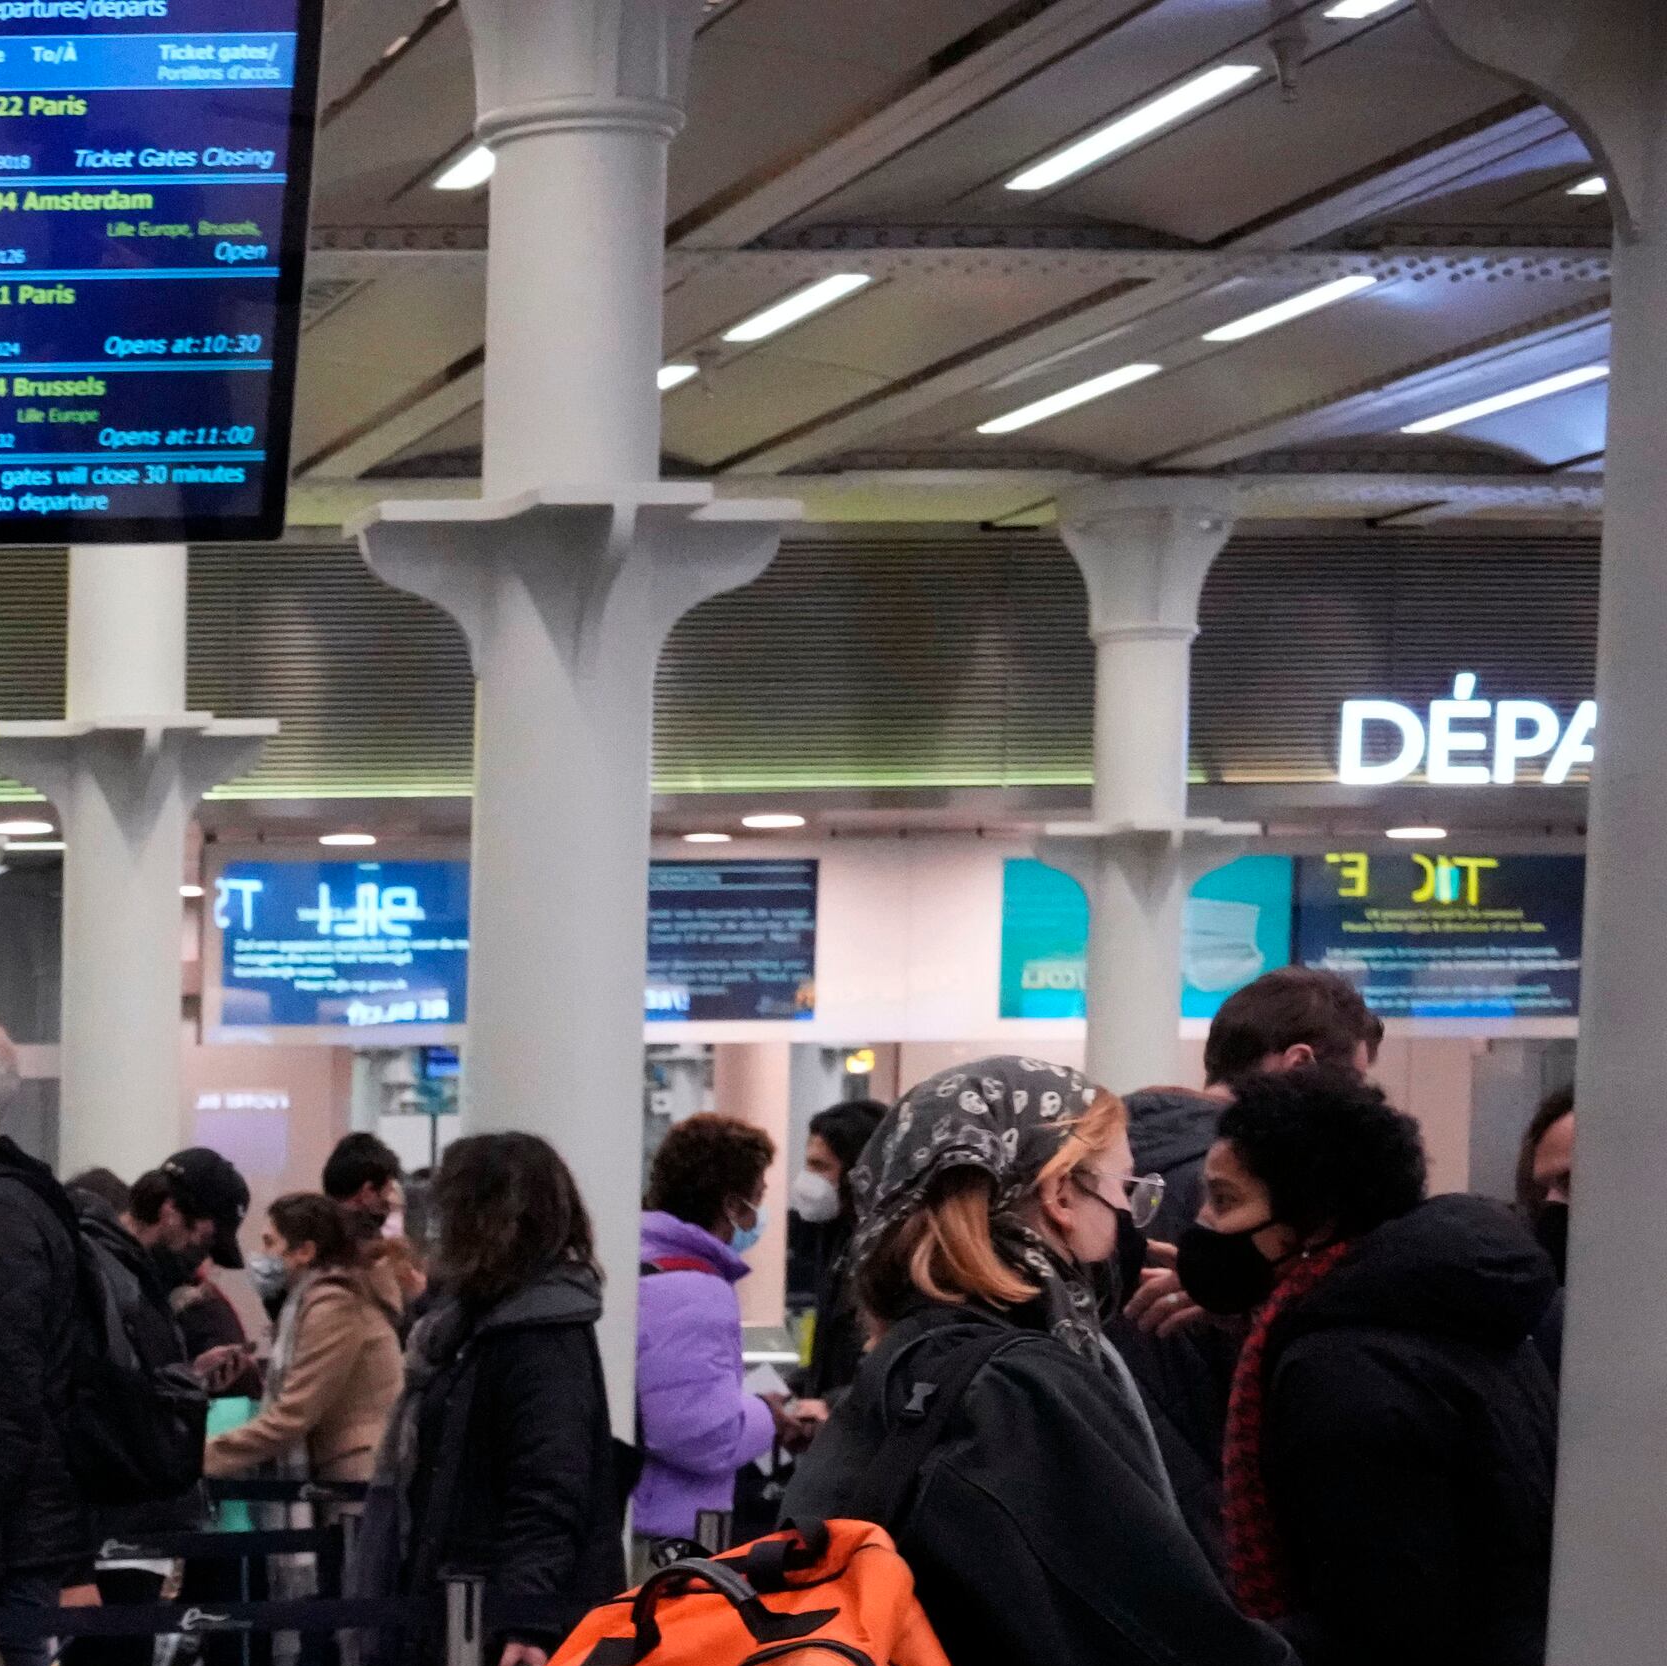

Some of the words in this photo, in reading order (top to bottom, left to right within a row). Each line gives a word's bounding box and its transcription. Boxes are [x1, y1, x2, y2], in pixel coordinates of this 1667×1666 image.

[158, 44, 215, 61] Ticket
[219, 42, 278, 63] gates/
[29, 96, 87, 116] Paris
[75, 149, 134, 168] Ticket
[139, 148, 195, 168] Gates
[202, 147, 274, 171] Closing
[23, 189, 153, 211] Amsterdam
[215, 242, 267, 263] Open
[18, 284, 76, 305] Paris
[104, 336, 167, 357] Opens
[13, 376, 106, 397] Brussels
[98, 428, 160, 448] Opens
[1, 468, 53, 488] gates
[57, 466, 88, 485] will
[92, 466, 140, 484] close
[143, 466, 168, 484] 30
[172, 465, 246, 484] minutes
[18, 493, 108, 513] departure
